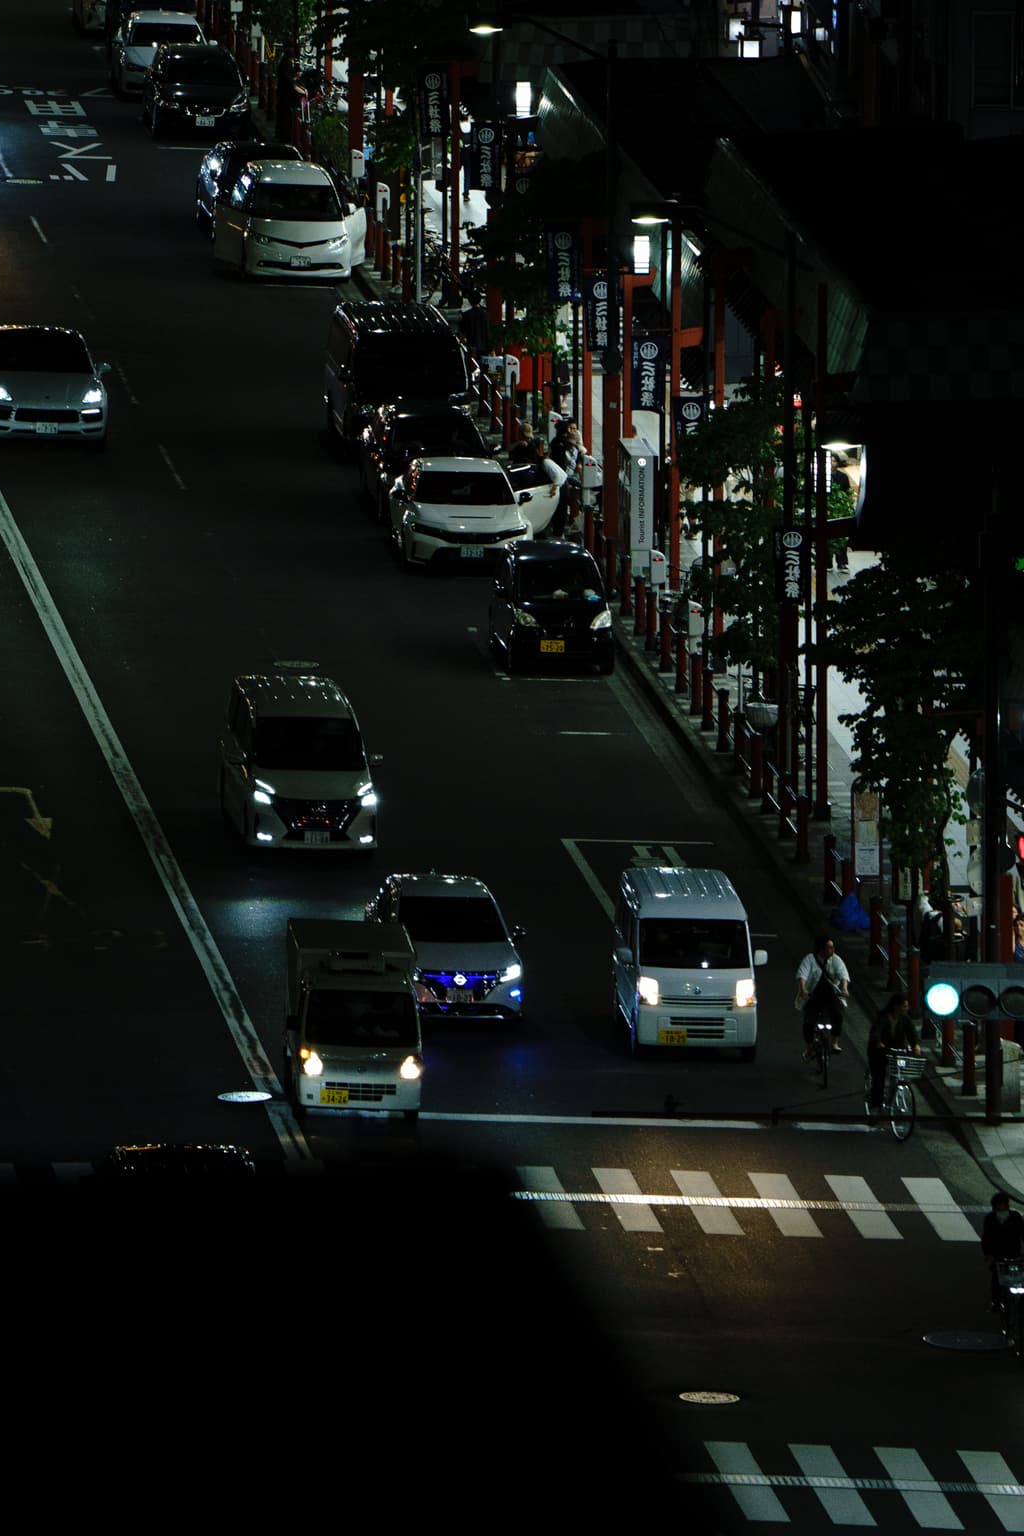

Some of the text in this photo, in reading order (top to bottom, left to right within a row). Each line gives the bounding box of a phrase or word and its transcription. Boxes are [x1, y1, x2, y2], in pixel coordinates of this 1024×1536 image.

[427, 90, 441, 134] 三社祭
[23, 100, 118, 182] バス専用
[480, 145, 493, 188] 三社祭
[557, 251, 573, 298] 三社祭
[594, 300, 609, 348] 三社祭
[639, 361, 657, 408] 三社祭
[638, 467, 646, 544] Tourist INFORMATION
[784, 550, 801, 599] 三社祭
